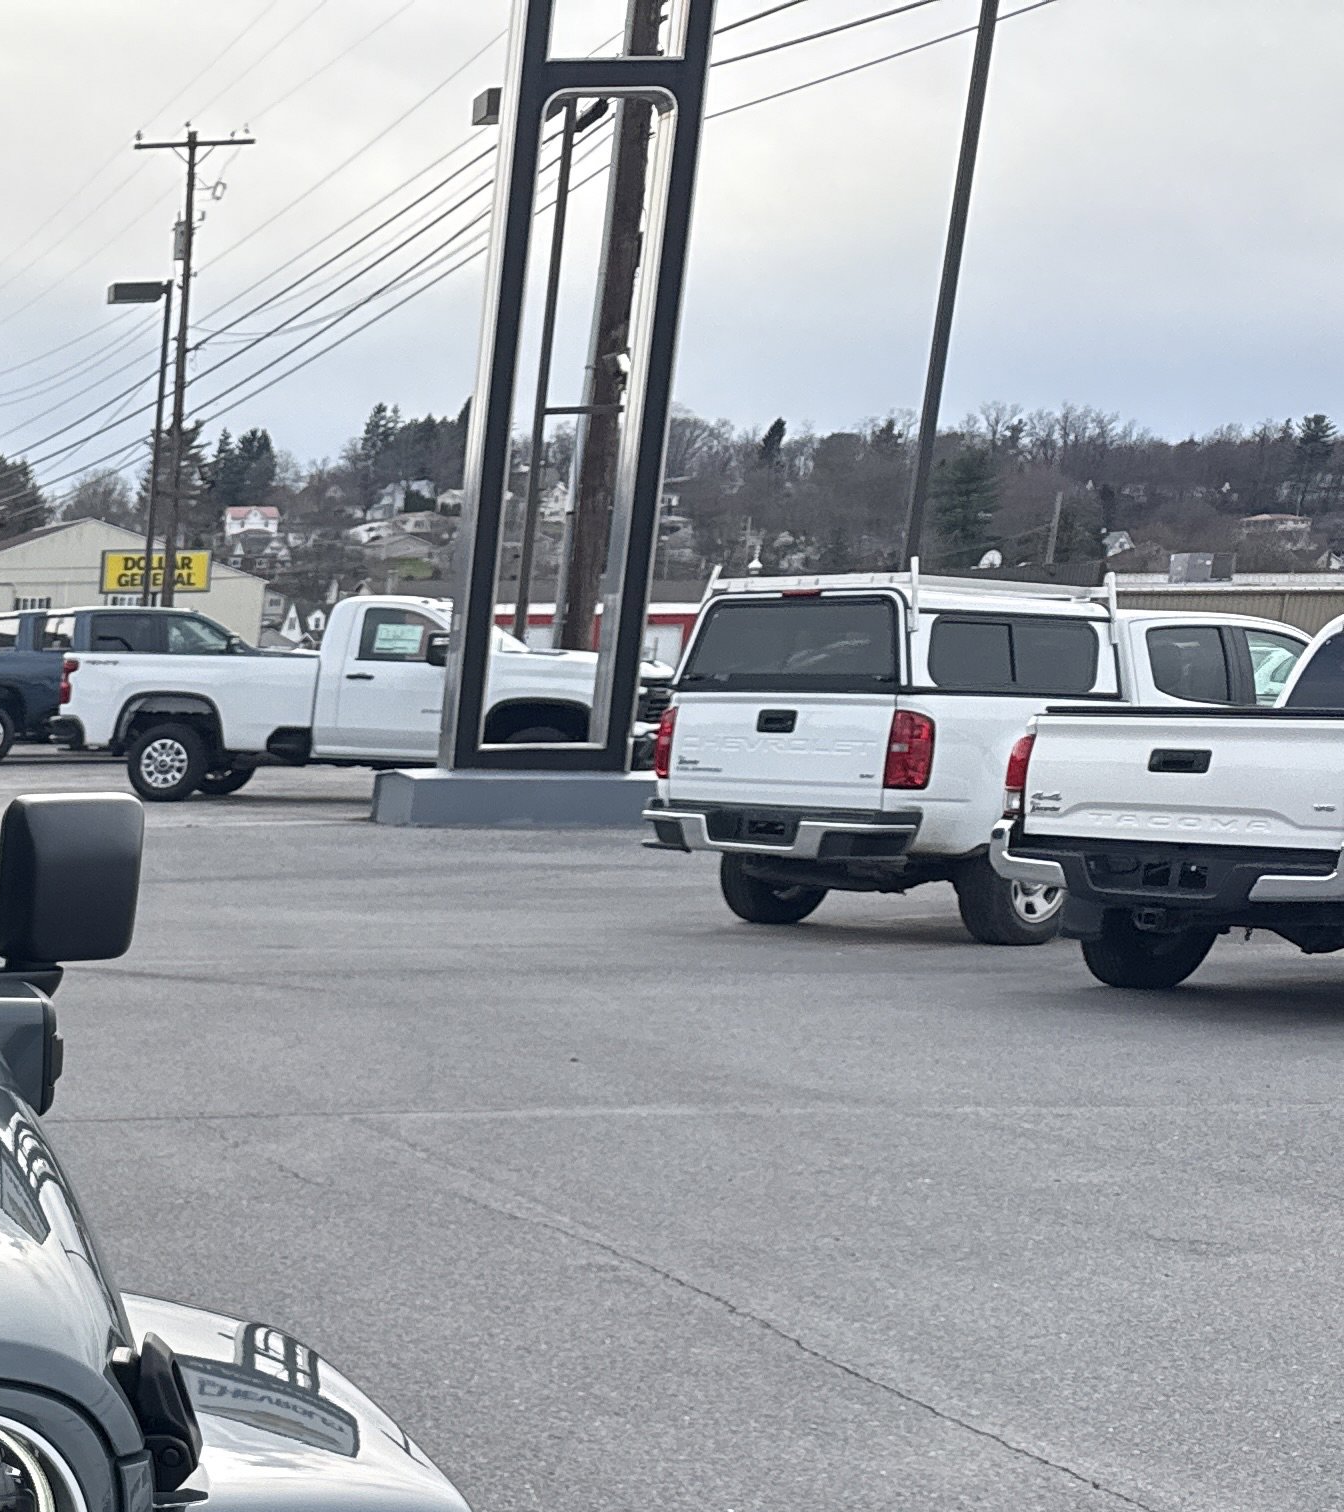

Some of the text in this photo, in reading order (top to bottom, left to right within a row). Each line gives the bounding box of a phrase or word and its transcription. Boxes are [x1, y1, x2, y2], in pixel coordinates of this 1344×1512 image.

[123, 556, 193, 571] DOLR
[117, 572, 196, 587] GEEAL
[1088, 812, 1272, 834] TACOMA
